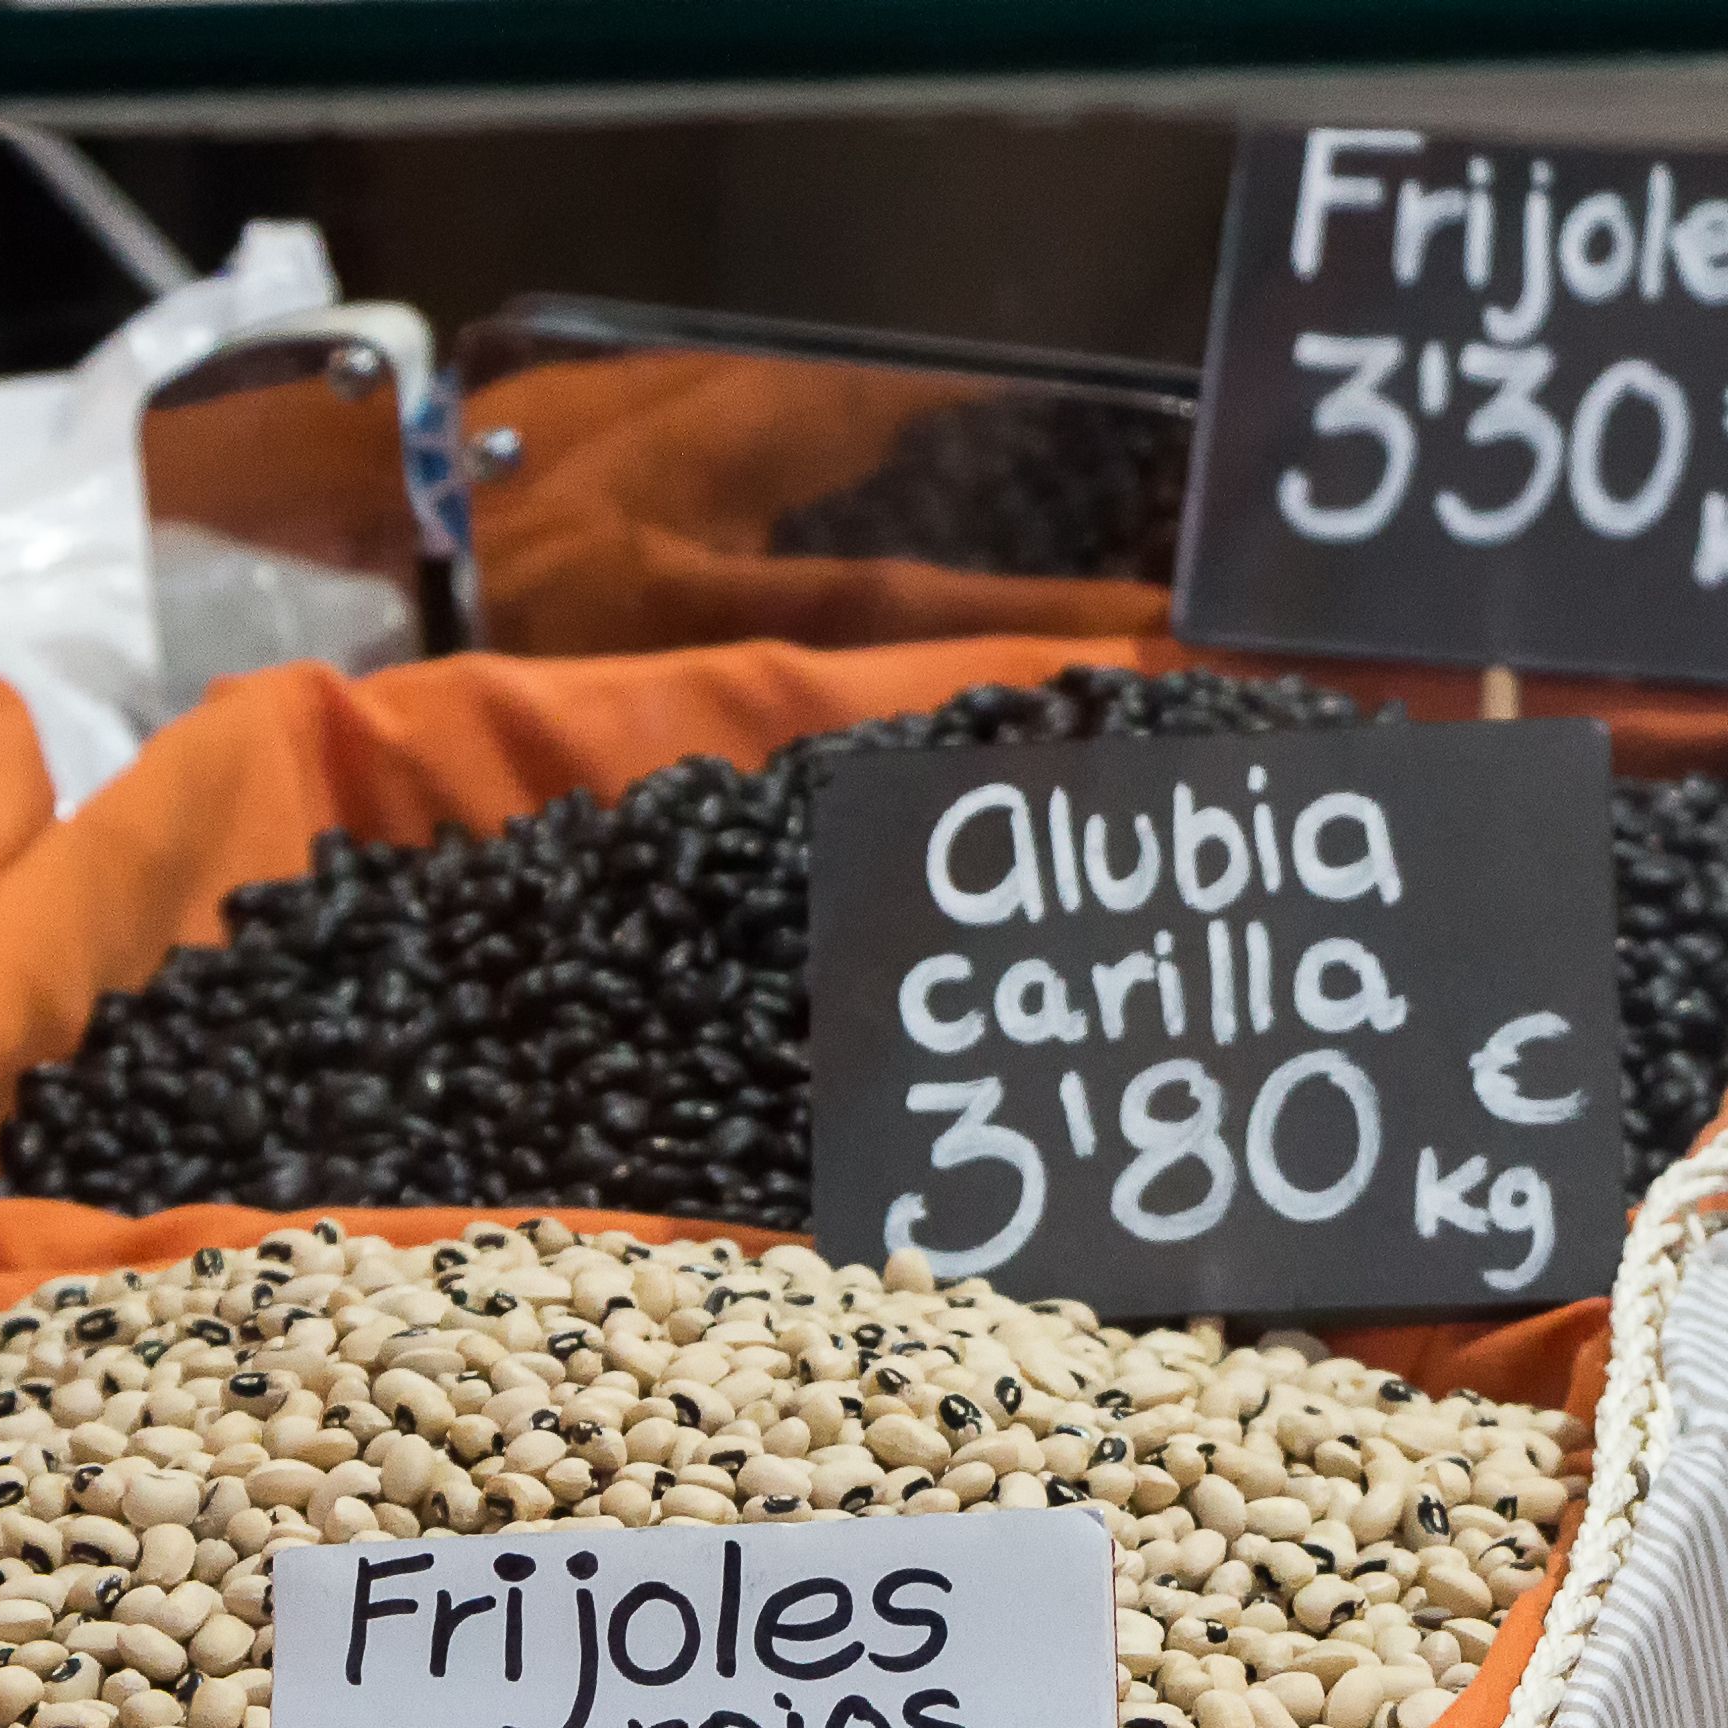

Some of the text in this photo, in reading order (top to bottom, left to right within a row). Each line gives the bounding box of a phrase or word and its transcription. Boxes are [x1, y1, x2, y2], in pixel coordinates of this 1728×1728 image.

[1276, 332, 1693, 547] 3'30
[898, 919, 1408, 1054] carilla
[883, 1011, 1586, 1279] 3'80 €
